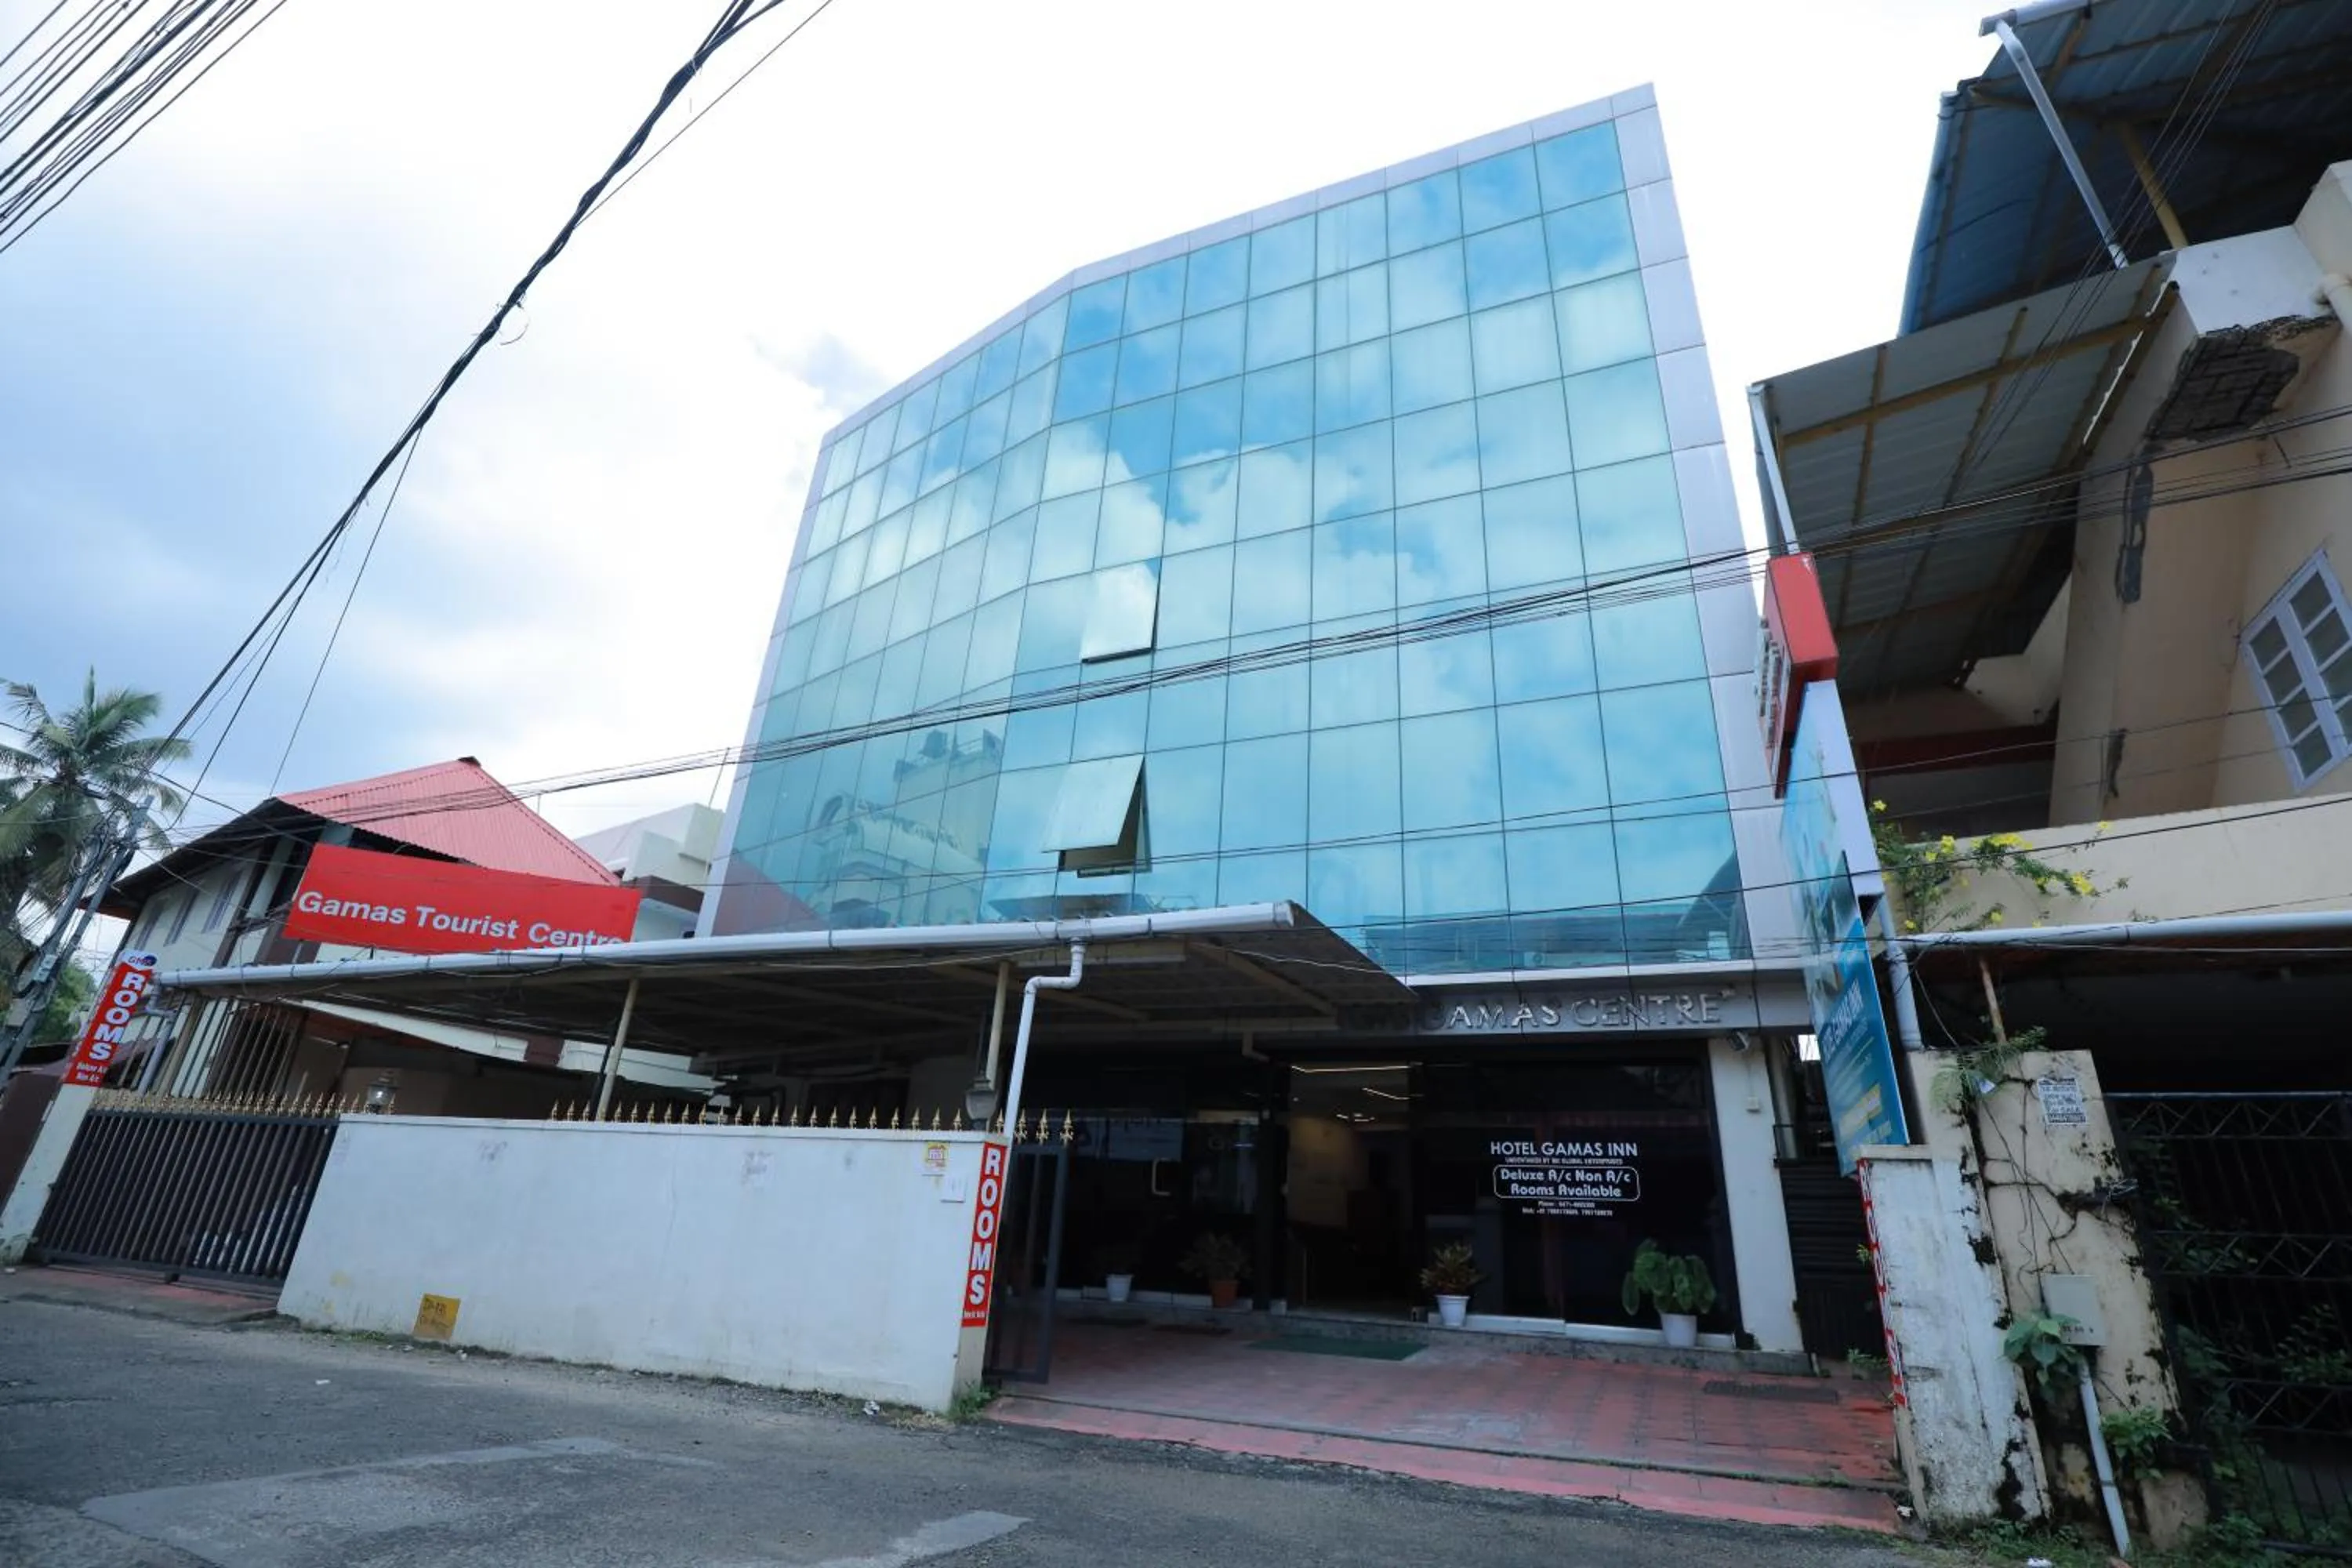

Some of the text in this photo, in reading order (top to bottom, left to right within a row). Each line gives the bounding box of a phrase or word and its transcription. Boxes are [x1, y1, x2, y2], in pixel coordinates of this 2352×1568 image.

[298, 891, 406, 924] Gamas
[416, 906, 519, 939] Tourist
[89, 971, 146, 1061] ROOMS
[1572, 993, 1722, 1028] CENTRE
[1490, 1142, 1638, 1157] HOTEL GAMAS INN
[1501, 1168, 1631, 1185] Deluxe A/c Non A/c
[1511, 1184, 1623, 1197] Rooms Available
[968, 1147, 1002, 1306] ROOMS
